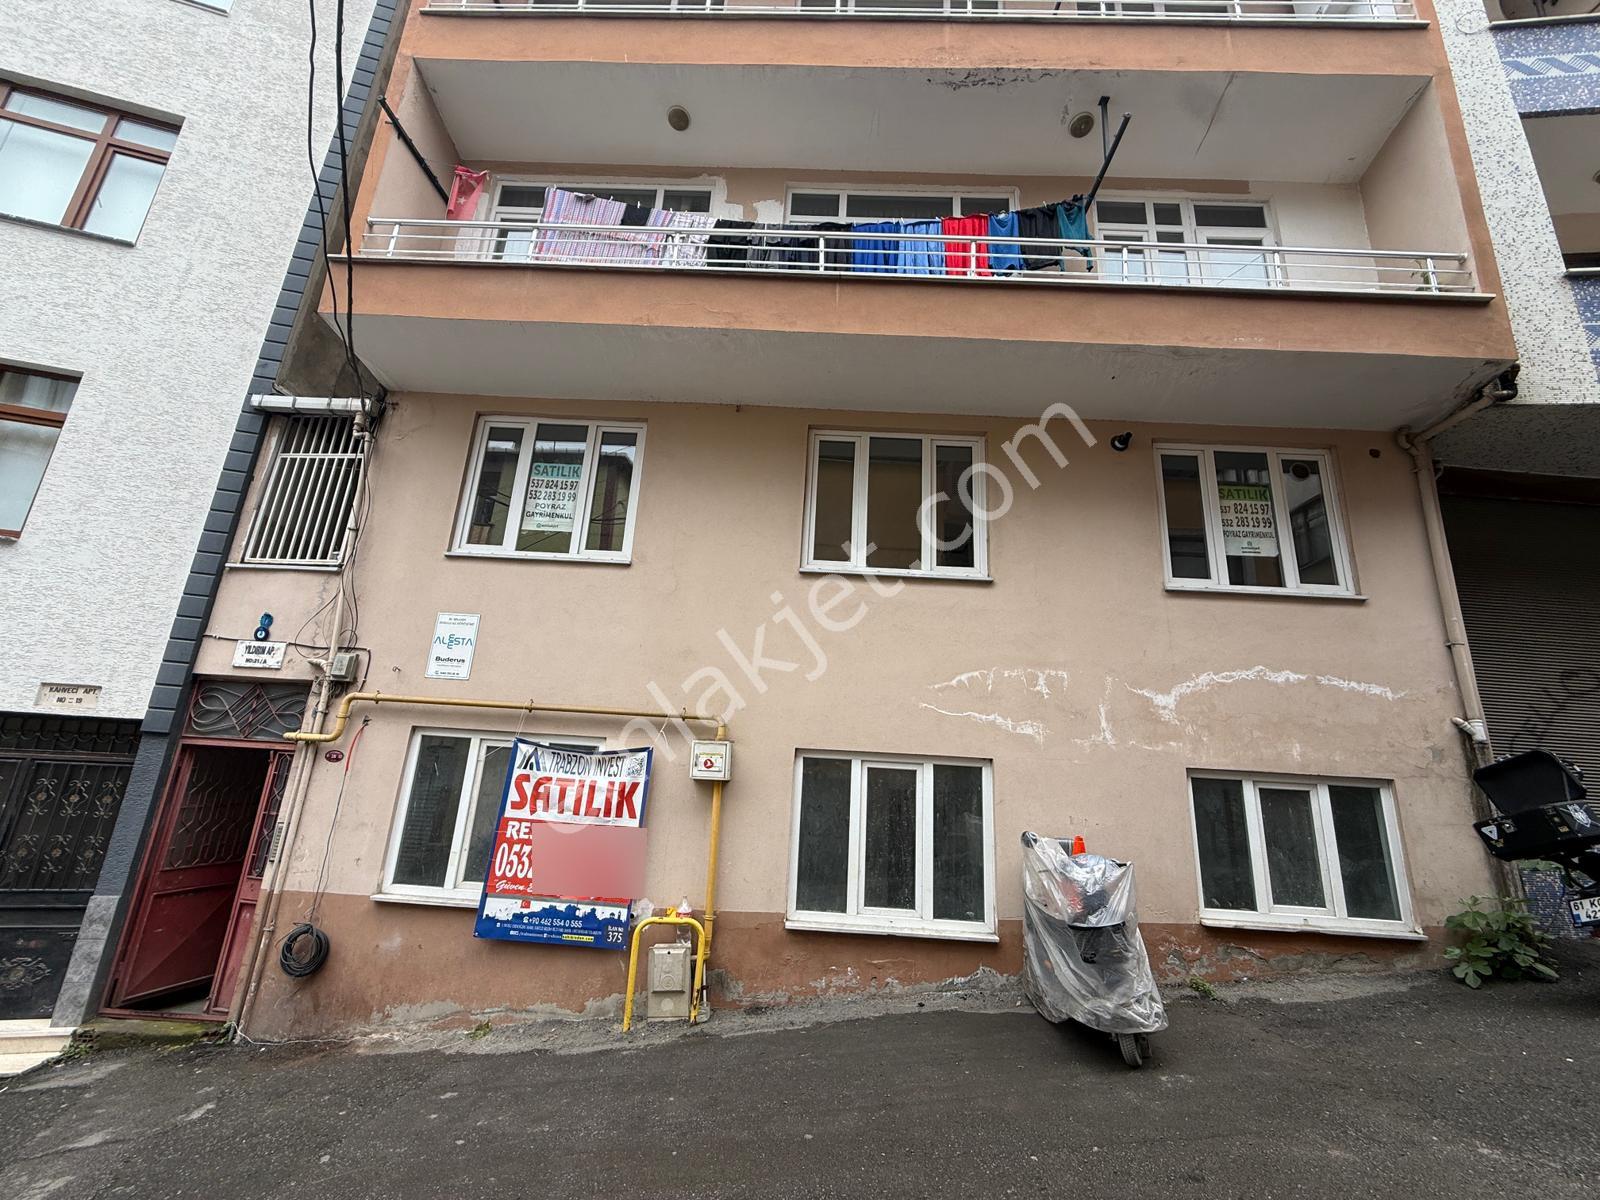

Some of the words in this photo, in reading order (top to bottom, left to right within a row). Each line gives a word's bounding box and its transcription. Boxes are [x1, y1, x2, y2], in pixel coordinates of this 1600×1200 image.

[533, 465, 580, 477] SATILIK
[531, 479, 544, 488] 537
[544, 480, 558, 490] 824
[560, 481, 568, 490] 15
[570, 481, 578, 490] 97
[529, 490, 542, 500] 532
[543, 491, 556, 501] 283
[558, 492, 566, 501] 19
[567, 492, 576, 502] 99
[1219, 488, 1268, 500] SATILIK
[1220, 506, 1230, 514] 537
[1234, 503, 1248, 514] 824
[1250, 504, 1258, 514] 15
[1260, 504, 1270, 515] 97
[1222, 518, 1234, 528] 532
[1236, 516, 1250, 528] 283
[1252, 517, 1260, 528] 19
[1262, 518, 1272, 528] 99
[548, 752, 593, 776] TRABZON
[510, 774, 640, 819] SATILIK
[506, 820, 532, 840] RE
[1573, 901, 1584, 910] 61
[1586, 910, 1600, 919] 42
[570, 920, 582, 928] 555
[606, 932, 623, 943] 375
